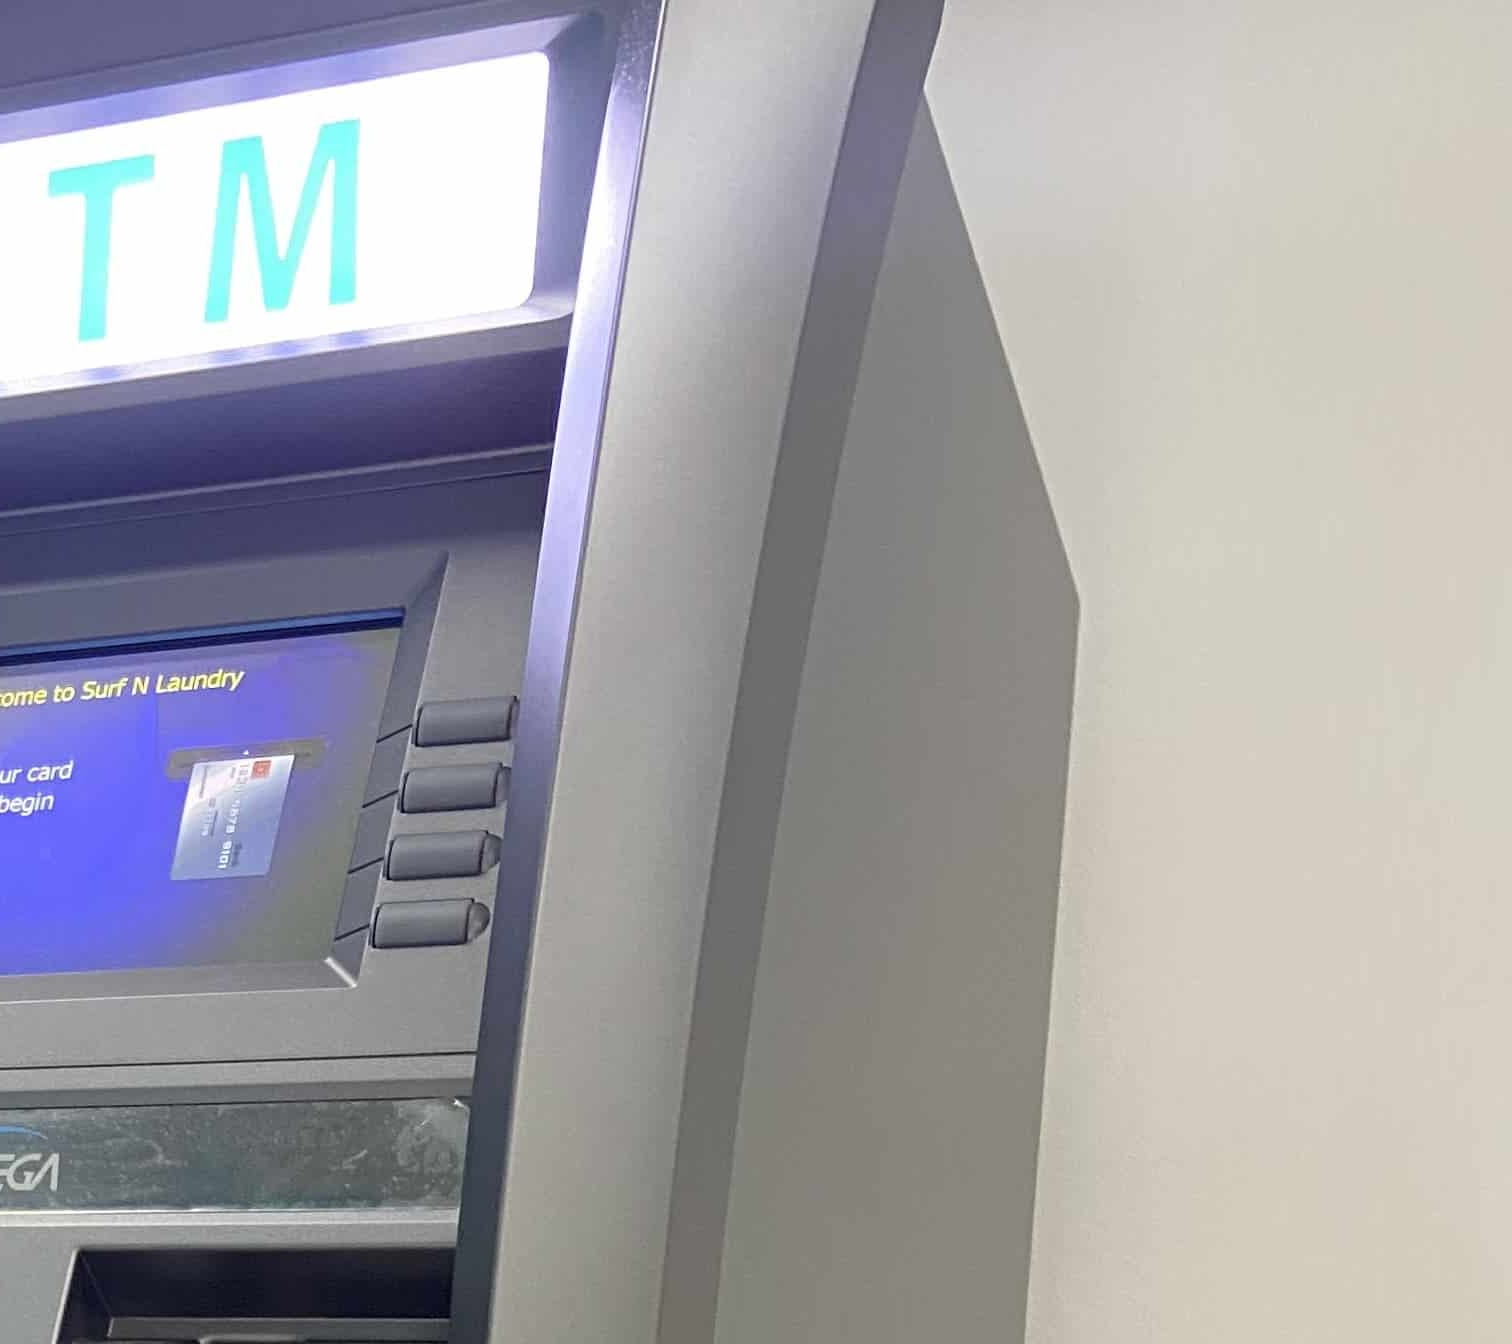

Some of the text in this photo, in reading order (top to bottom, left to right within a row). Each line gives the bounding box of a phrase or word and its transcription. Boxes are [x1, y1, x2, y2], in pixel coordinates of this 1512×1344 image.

[53, 684, 75, 703] to
[80, 677, 129, 701] Surf
[131, 675, 151, 695] N
[155, 669, 245, 694] Laundry
[26, 760, 74, 783] card
